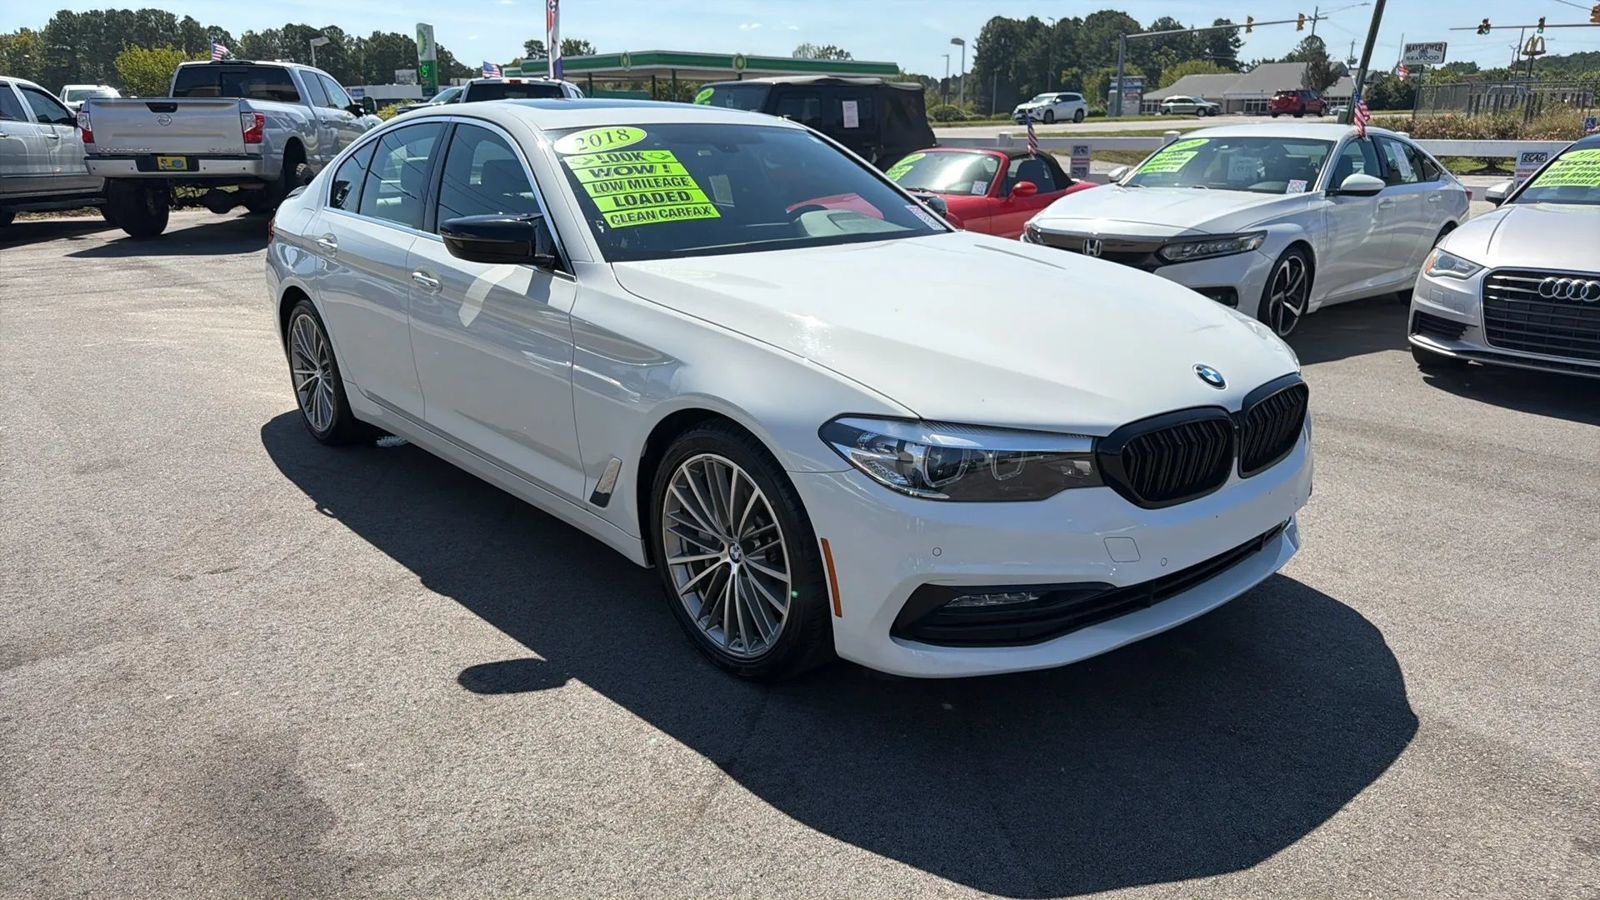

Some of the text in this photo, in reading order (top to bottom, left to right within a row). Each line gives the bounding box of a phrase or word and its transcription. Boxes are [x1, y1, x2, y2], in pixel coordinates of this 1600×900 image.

[575, 128, 631, 151] 2018
[598, 152, 645, 164] LOOK
[589, 165, 657, 178] WOW
[592, 176, 692, 194] LOW MILEAGE
[613, 190, 692, 208] LOADED
[610, 205, 713, 225] CLEAN CARFAX
